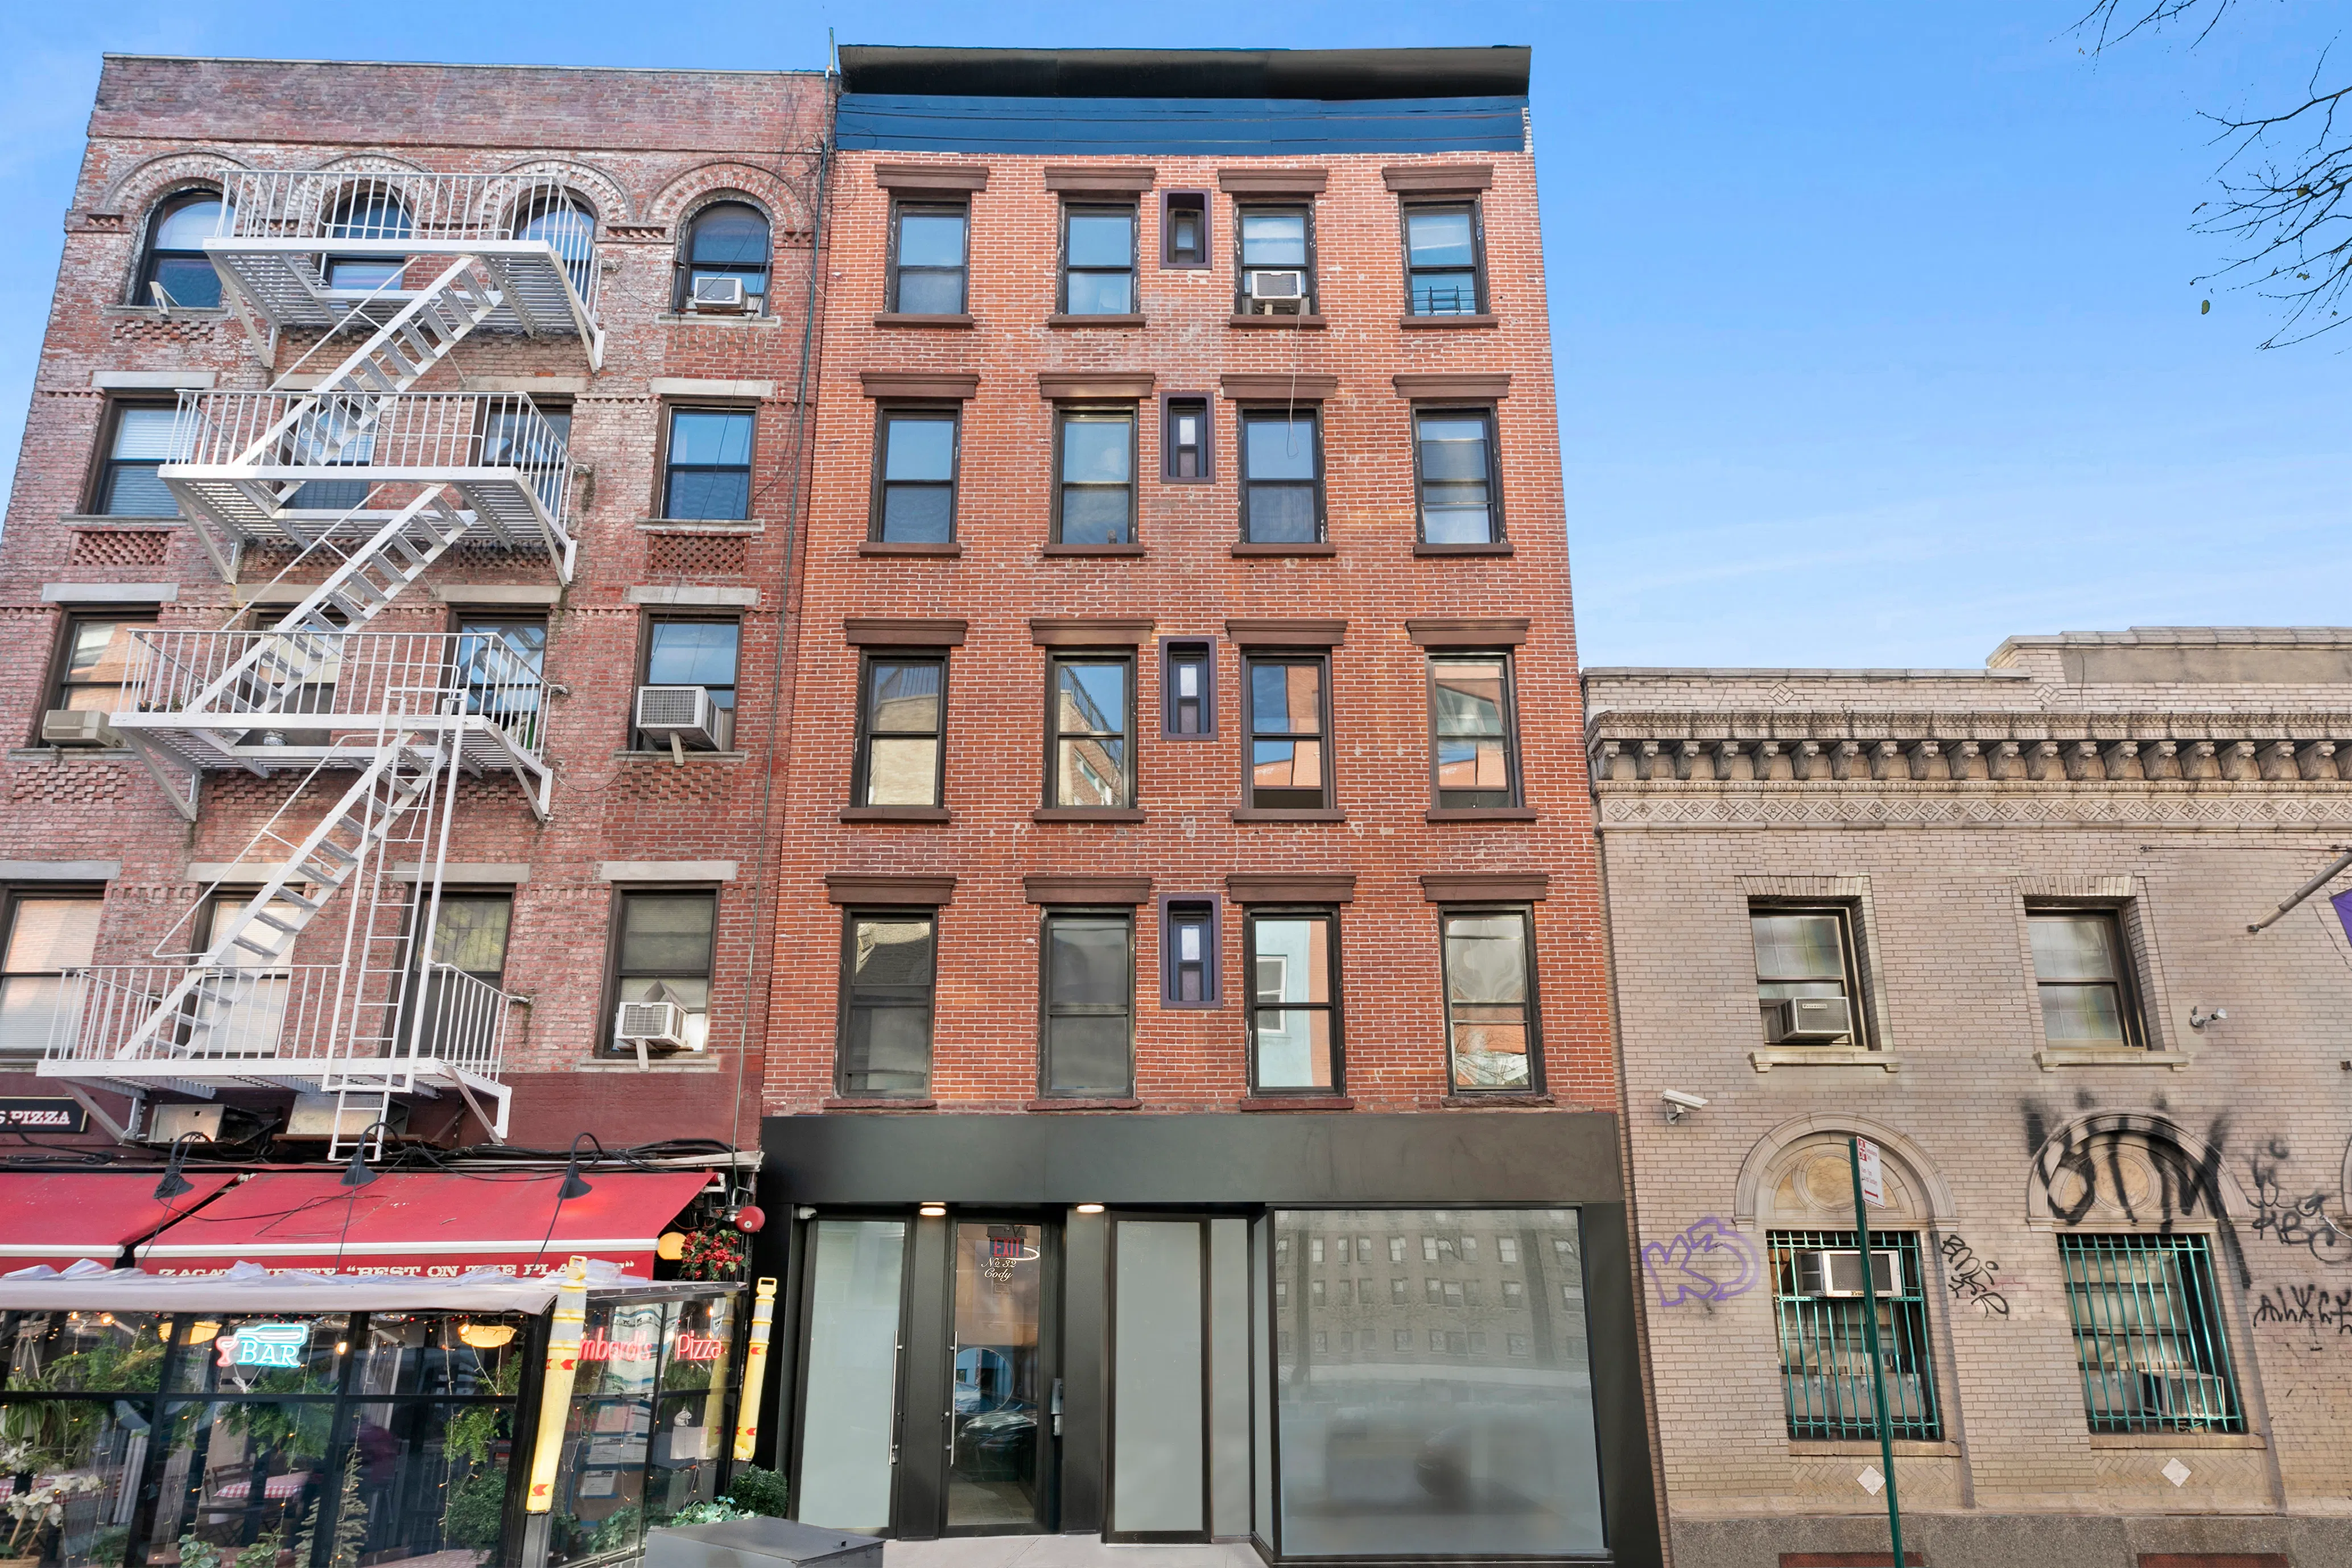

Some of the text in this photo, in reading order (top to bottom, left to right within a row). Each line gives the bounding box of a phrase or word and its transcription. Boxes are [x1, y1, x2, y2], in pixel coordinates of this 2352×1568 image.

[8, 1111, 71, 1124] PIZZA
[994, 1237, 1020, 1257] EXIT
[427, 1266, 459, 1277] ON
[984, 1268, 1013, 1282] Cody
[236, 1339, 301, 1368] BAR
[675, 1330, 722, 1360] Pizza
